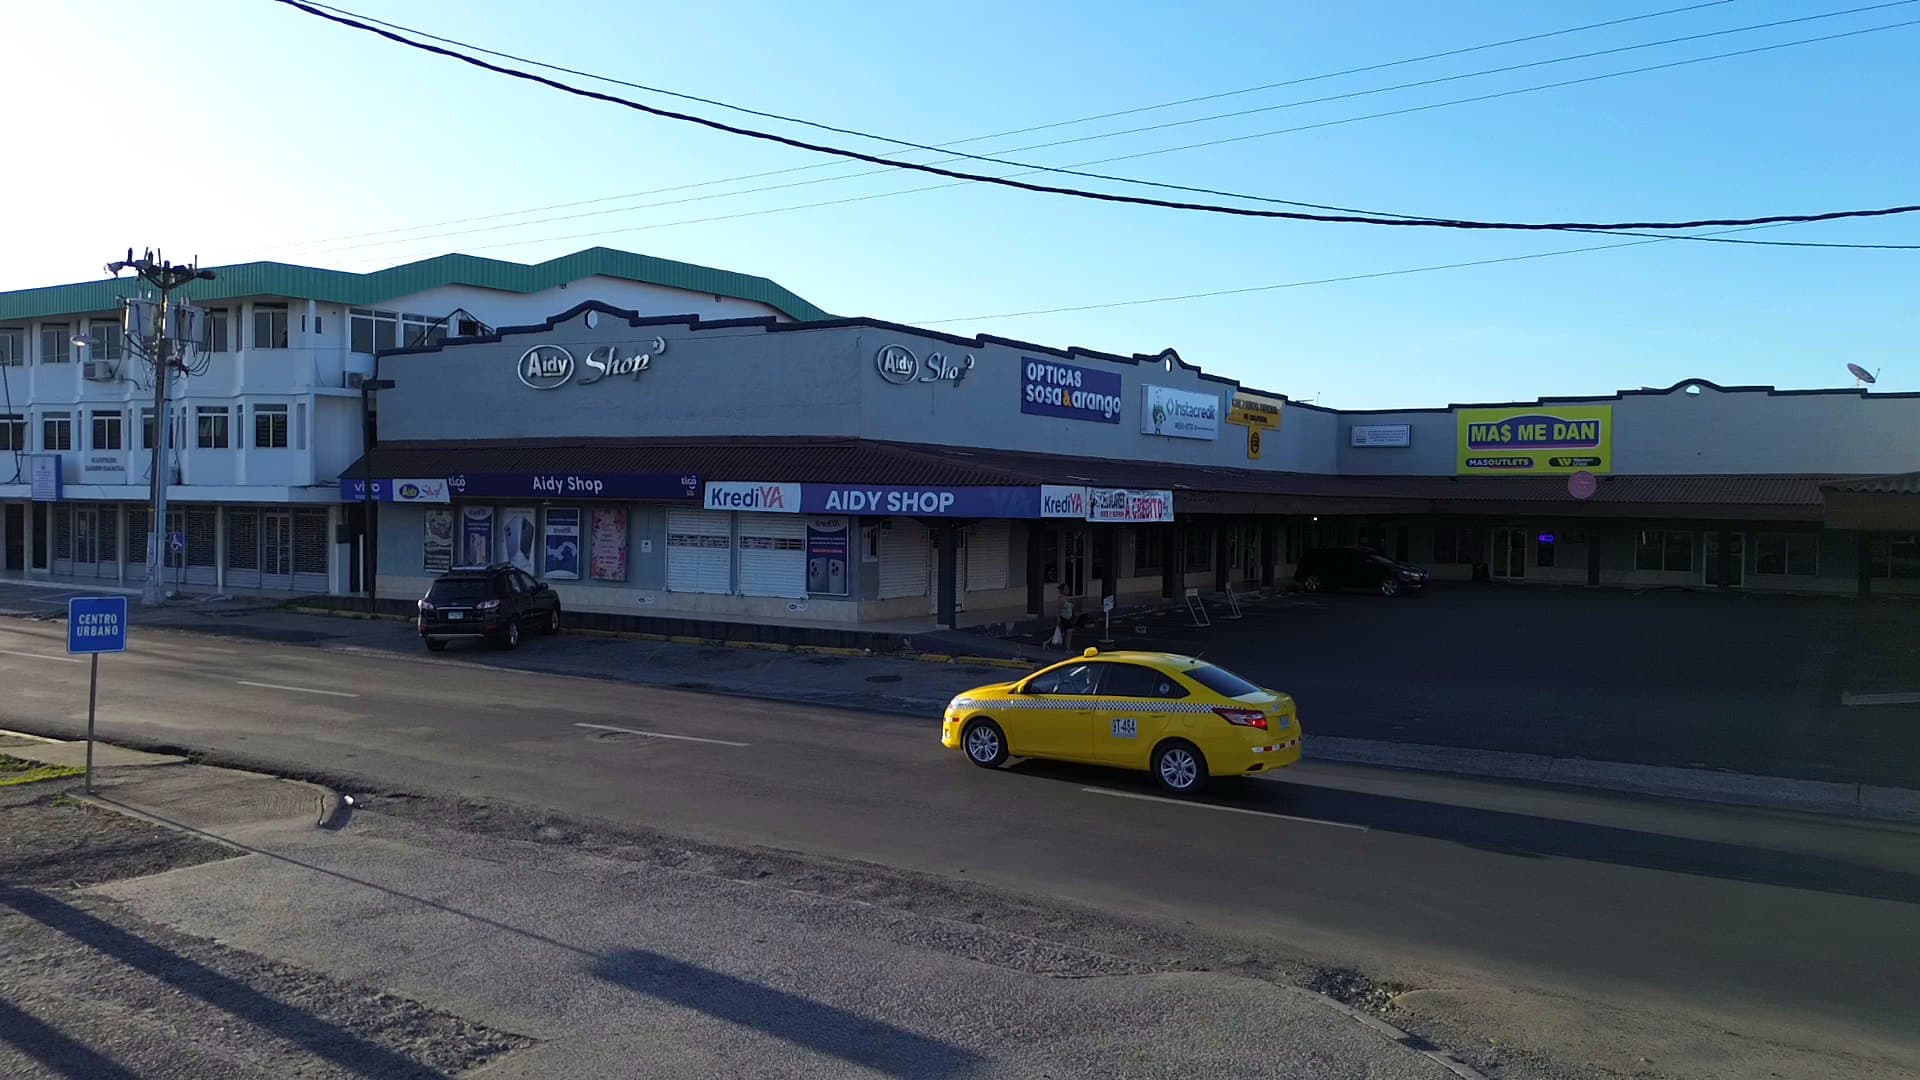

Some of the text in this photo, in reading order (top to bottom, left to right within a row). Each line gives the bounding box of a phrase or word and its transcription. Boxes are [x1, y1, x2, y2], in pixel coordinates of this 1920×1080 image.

[528, 346, 650, 385] Aidy Shop
[884, 349, 914, 375] Aidy
[1027, 362, 1082, 388] OPTICAS
[1518, 424, 1547, 441] ME
[1553, 422, 1595, 441] DAN
[353, 478, 381, 492] vio
[533, 475, 604, 495] Aidy Shop
[711, 486, 785, 509] KrediYA
[825, 489, 956, 514] AIDY SHOP
[1044, 493, 1082, 514] KrediYA
[78, 613, 118, 625] CENTRO
[76, 625, 119, 637] URBANO
